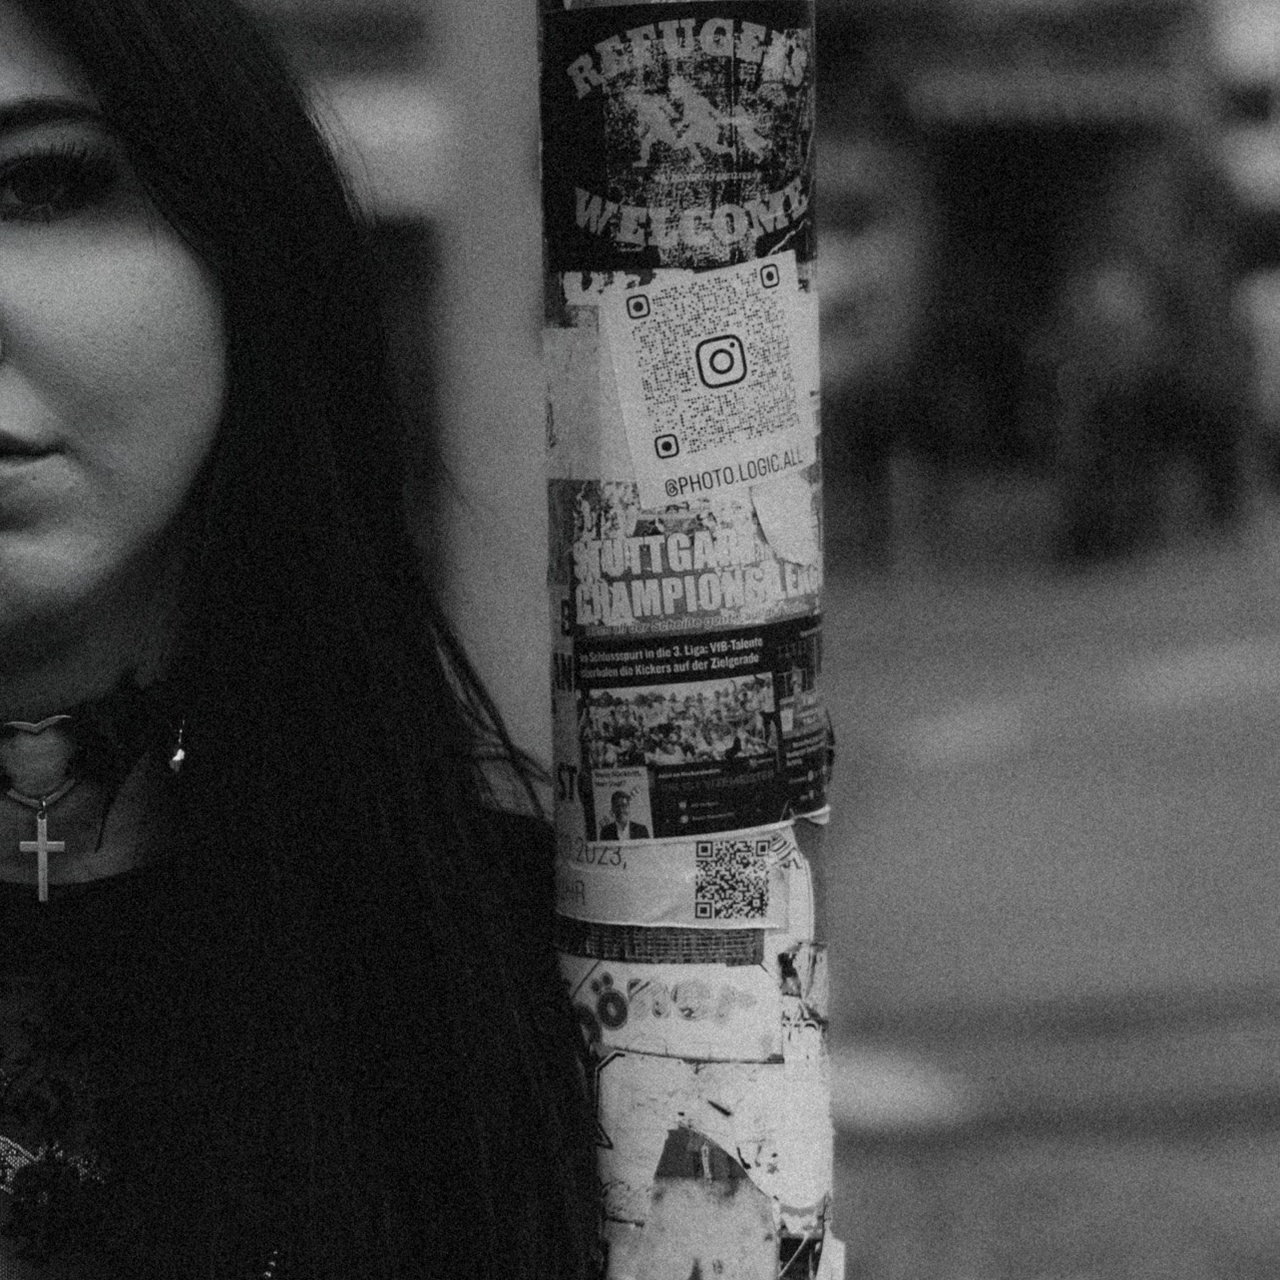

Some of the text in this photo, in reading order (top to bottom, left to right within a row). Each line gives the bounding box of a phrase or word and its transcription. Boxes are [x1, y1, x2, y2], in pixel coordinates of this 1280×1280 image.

[567, 17, 809, 100] REFUGEES
[574, 176, 811, 248] WELCOME
[663, 447, 804, 498] @PHOTO.LOGIC.ALL
[573, 528, 758, 580] STUTTGAR
[634, 662, 671, 676] Kickers
[673, 660, 690, 673] auf
[691, 658, 708, 671] der
[710, 651, 759, 670] Zielgerade
[672, 645, 683, 658] 3.
[684, 642, 708, 658] Liga:
[708, 637, 763, 654] VfB-Talente
